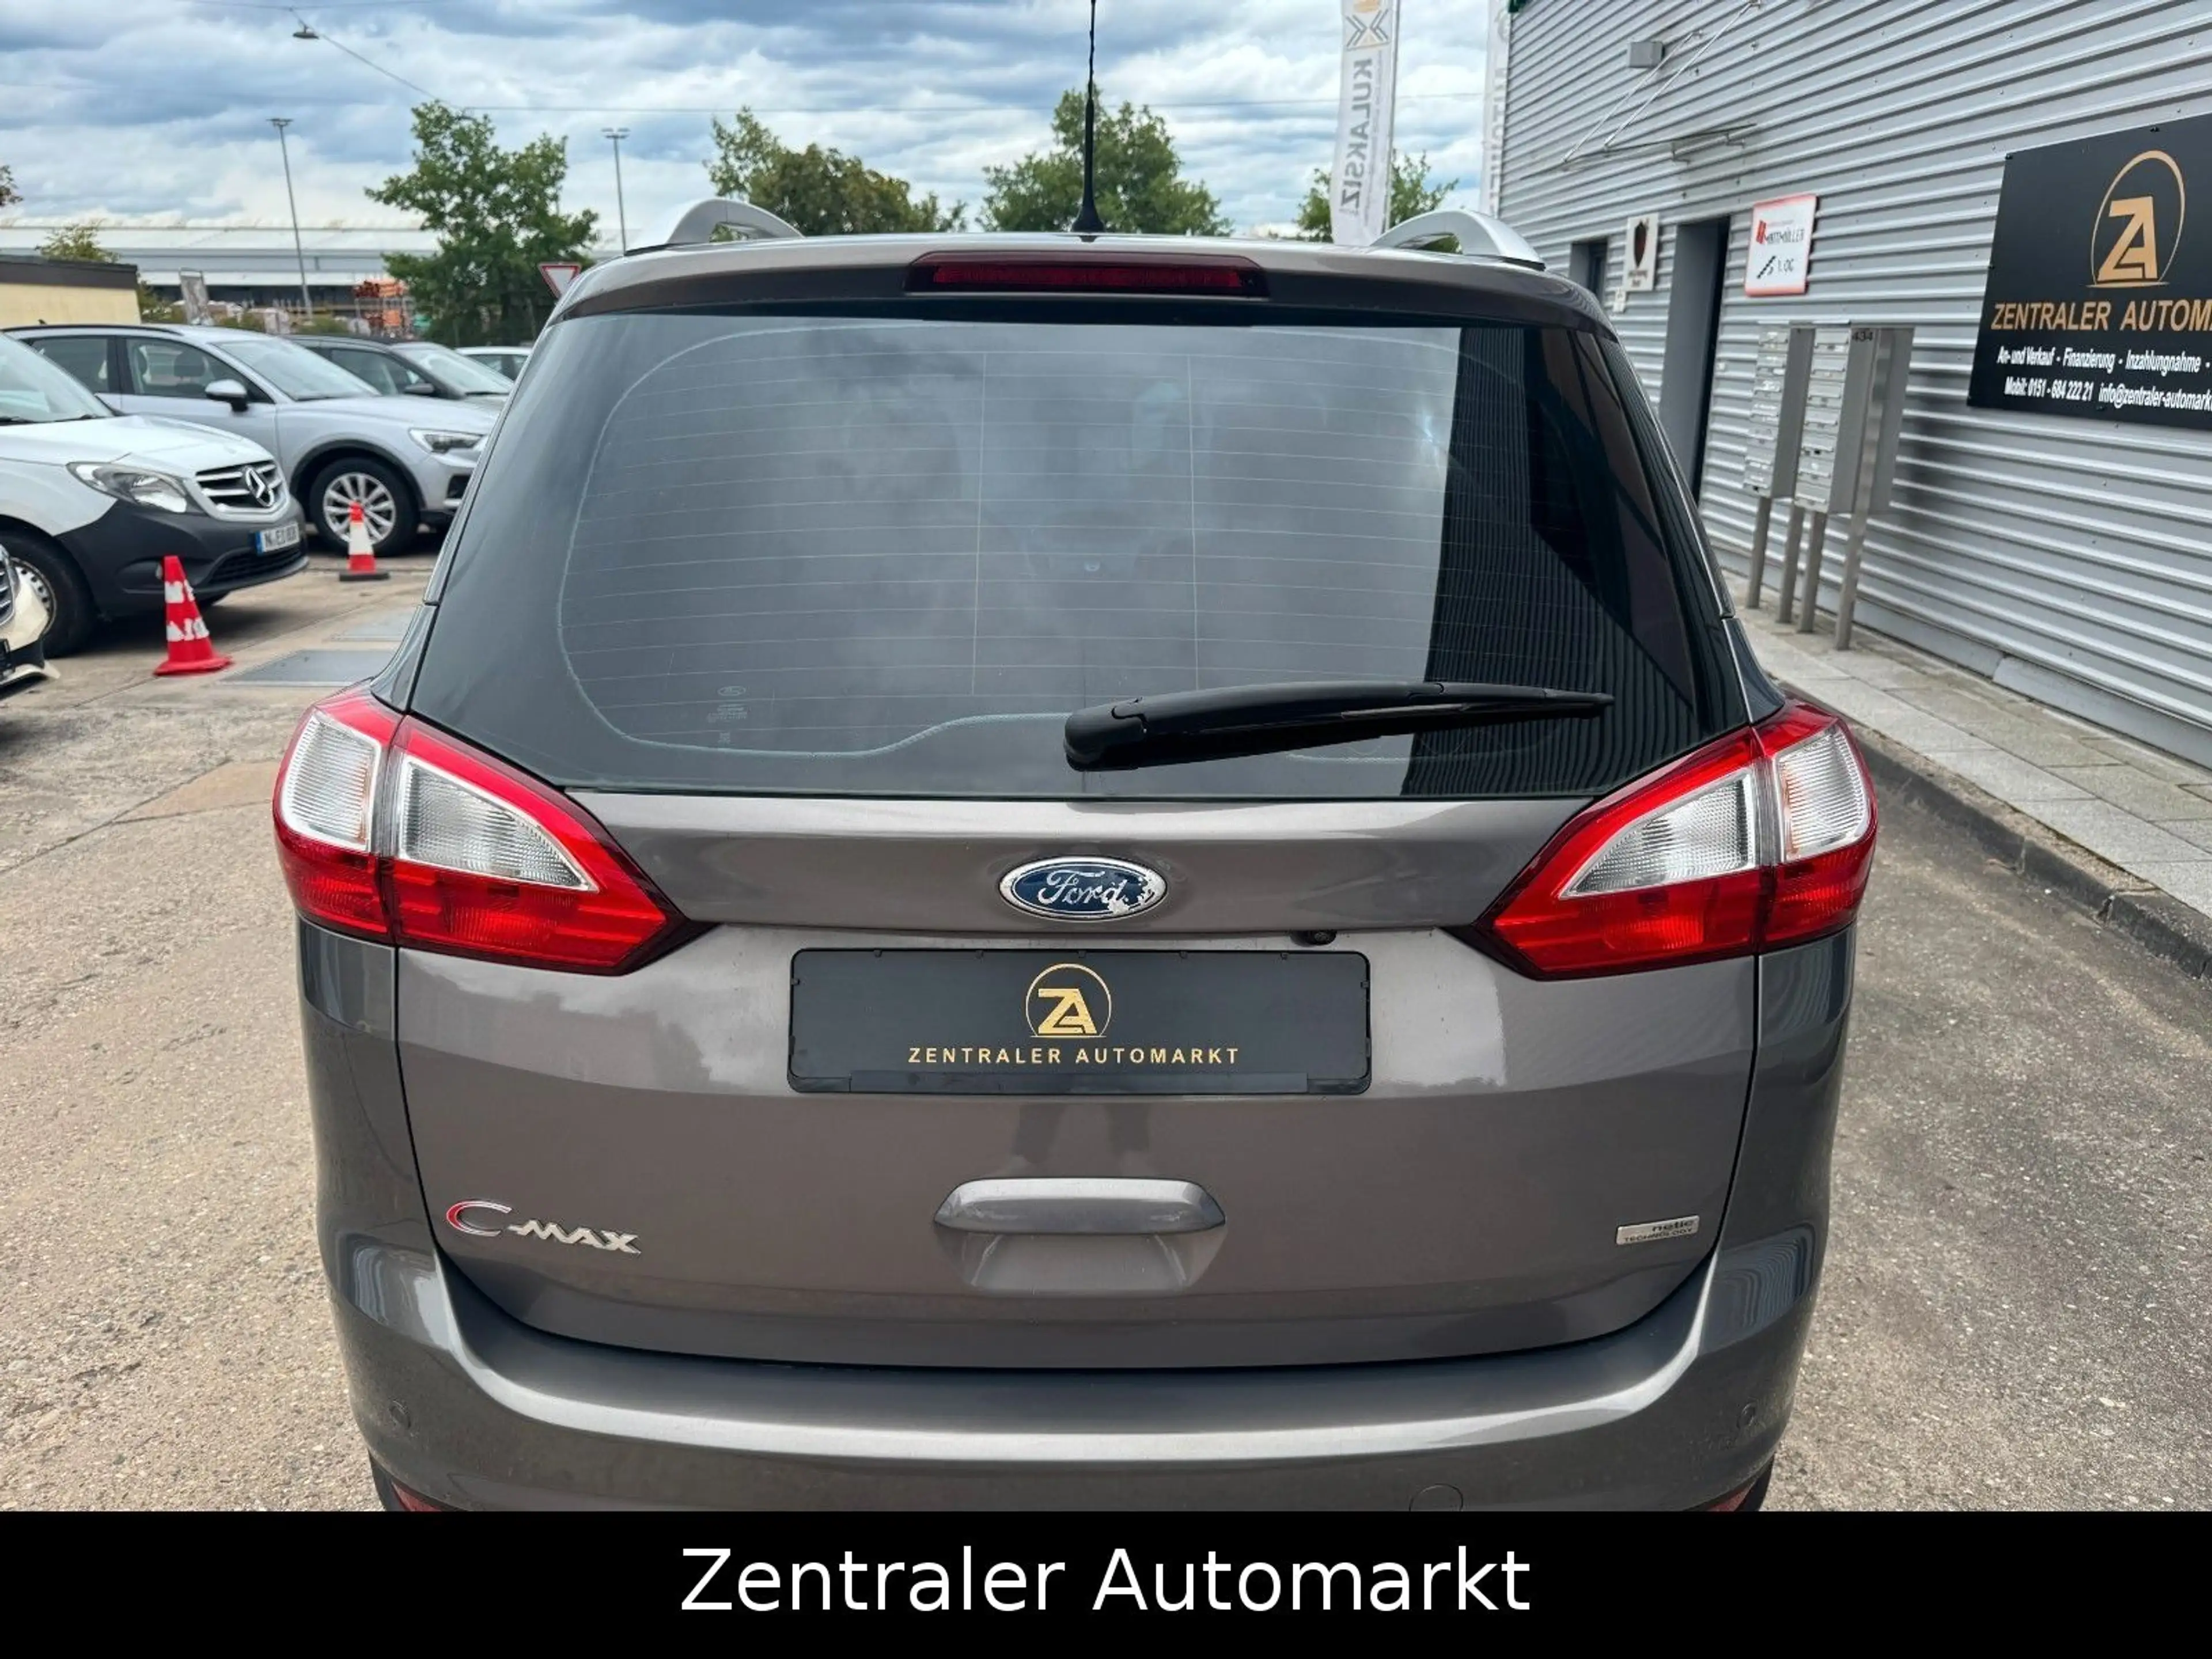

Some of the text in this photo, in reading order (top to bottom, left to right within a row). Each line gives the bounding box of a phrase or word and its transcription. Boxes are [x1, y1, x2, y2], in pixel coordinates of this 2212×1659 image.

[1991, 299, 2212, 331] ZENTRALER AUTOM
[2027, 346, 2056, 366] Verkauf
[2062, 347, 2116, 374] Finanzierung
[2124, 349, 2202, 377] Inzahlungnahme
[2027, 377, 2047, 397] 0151
[2051, 378, 2067, 399] 684
[2066, 380, 2083, 400] 222
[2082, 381, 2094, 402] 21
[2098, 382, 2212, 412] info@zentraler-automark
[1037, 869, 1128, 906] Ford
[908, 1047, 1238, 1064] ZENTRALER AUTOMARKT
